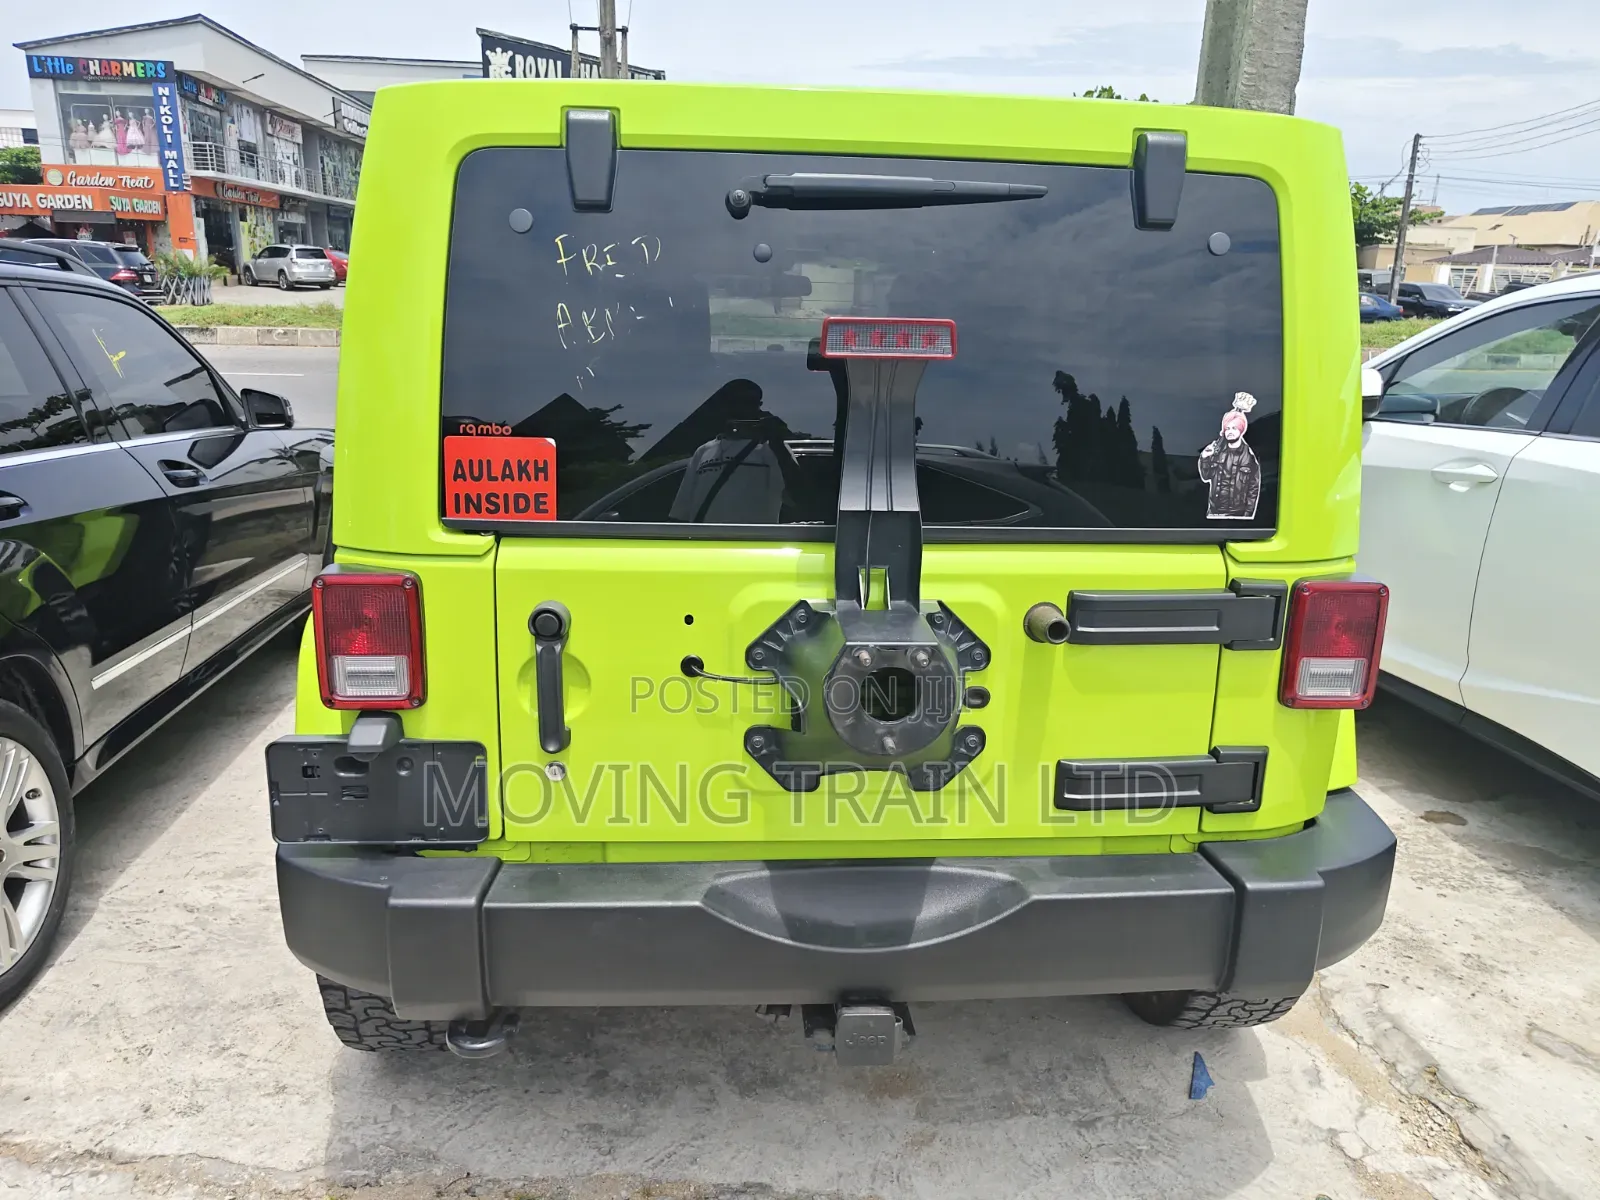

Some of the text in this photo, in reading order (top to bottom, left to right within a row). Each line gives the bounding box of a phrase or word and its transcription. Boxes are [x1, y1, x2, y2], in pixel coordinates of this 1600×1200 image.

[32, 56, 166, 79] Little CHARMERS
[157, 86, 180, 188] NIKOLI MALL
[66, 170, 155, 189] Garden Treat
[36, 193, 93, 209] GARDEN
[108, 195, 161, 214] SUYA GARDEN
[453, 459, 549, 482] AULAKH
[454, 492, 549, 515] INSIDE
